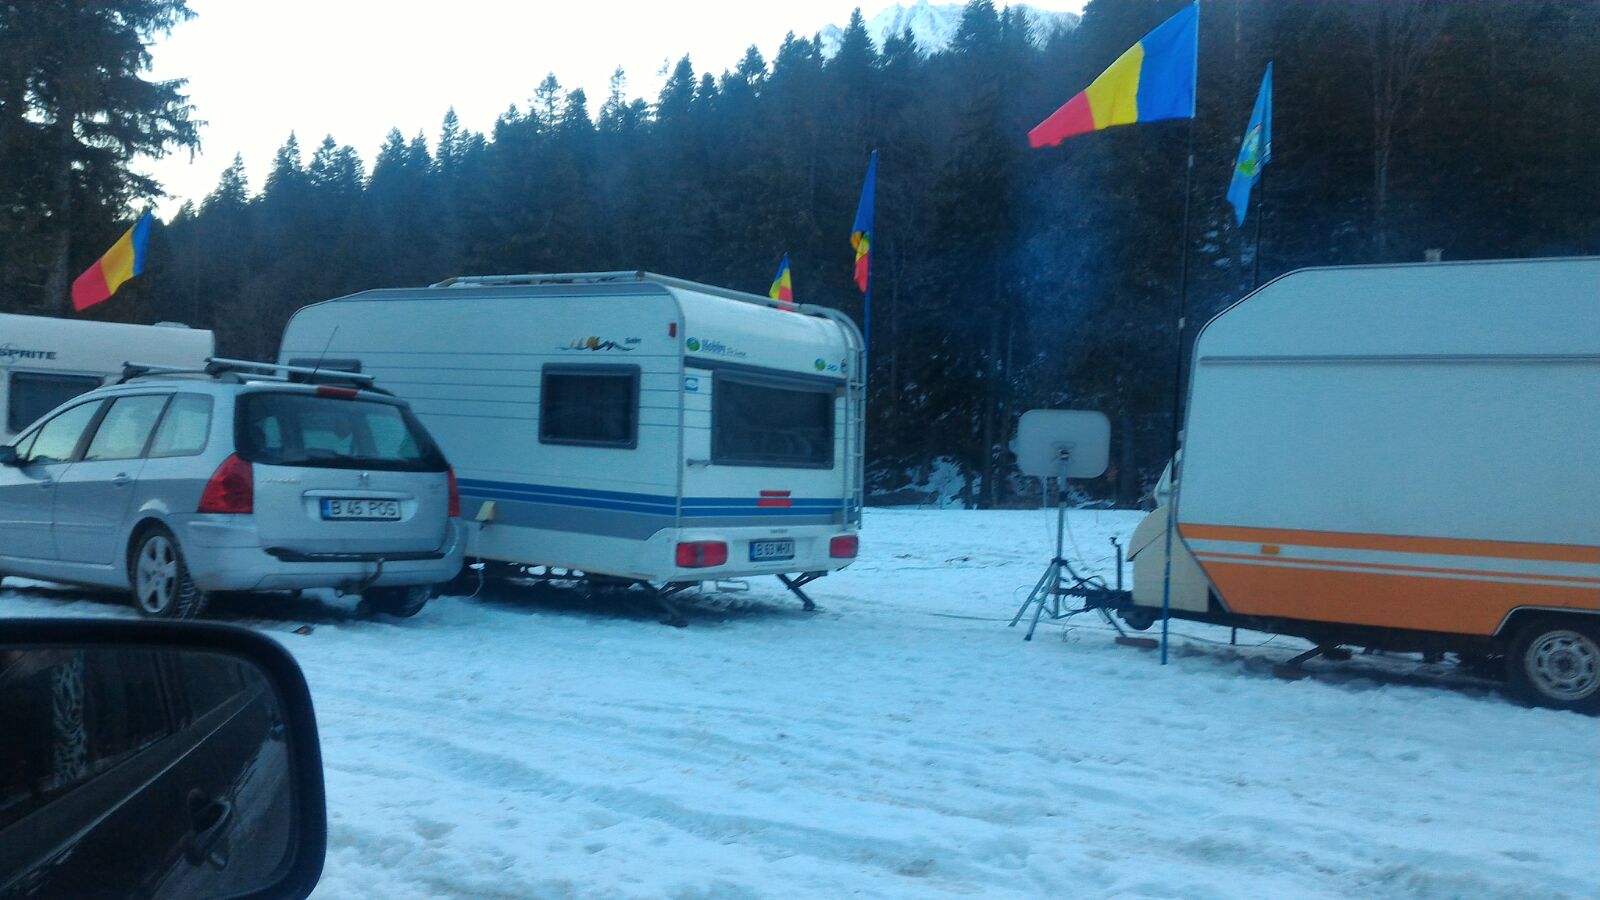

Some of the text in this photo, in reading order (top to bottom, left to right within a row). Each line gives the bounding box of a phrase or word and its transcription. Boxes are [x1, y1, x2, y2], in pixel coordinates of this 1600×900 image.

[0, 348, 57, 360] SPRITE
[331, 500, 397, 517] B 45 POS
[756, 543, 763, 556] B
